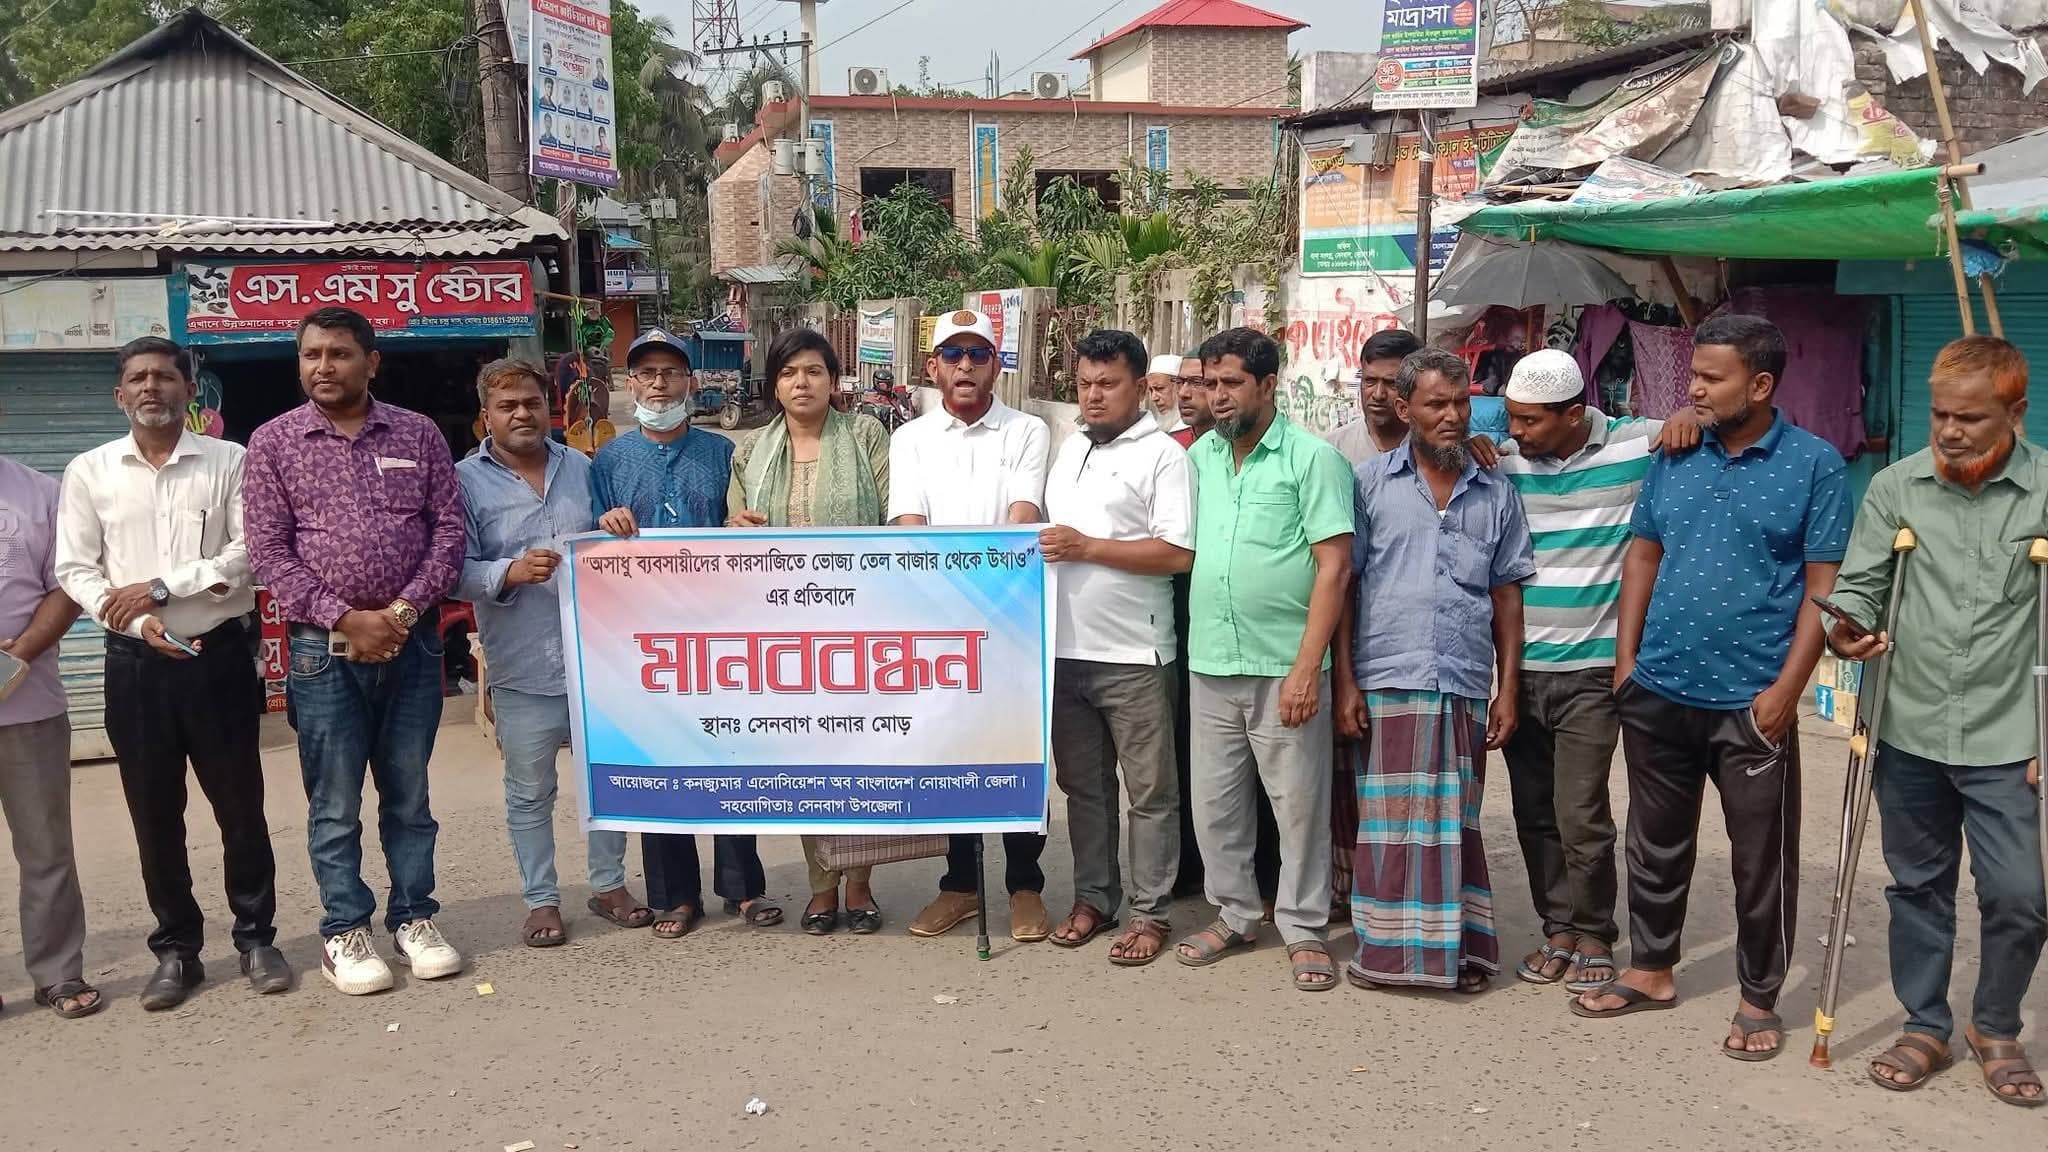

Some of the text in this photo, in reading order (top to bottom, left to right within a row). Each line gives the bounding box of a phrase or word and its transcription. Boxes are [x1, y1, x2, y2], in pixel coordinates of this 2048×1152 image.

[1385, 5, 1451, 27] মাদ্রাসা
[383, 274, 420, 314] সু
[426, 265, 523, 302] ষ্টোর
[188, 319, 218, 329] এখানে
[636, 548, 721, 574] ব্যবসায়ীদের
[725, 548, 807, 573] কারসাজিতে
[812, 551, 854, 572] ভোজ্য
[860, 551, 891, 571] তেল
[896, 550, 939, 571] বাজার
[945, 550, 982, 571] থেকে
[766, 582, 856, 607] এর প্রতিবাদে
[632, 630, 989, 695] মানববন্ধন
[700, 713, 913, 737] স্থানঃ সেনবাগ থানার মোড়
[608, 774, 668, 791] আয়োজনে
[683, 775, 742, 793] কনজ্যুমার
[746, 772, 826, 791] এসোসিয়েশন
[830, 775, 851, 790] অব
[855, 775, 914, 792] বাংলাদেশ
[919, 771, 981, 790] নোয়াখালী
[719, 796, 793, 814] সহযোগিতাঃ
[798, 798, 845, 814] সেনবাগ
